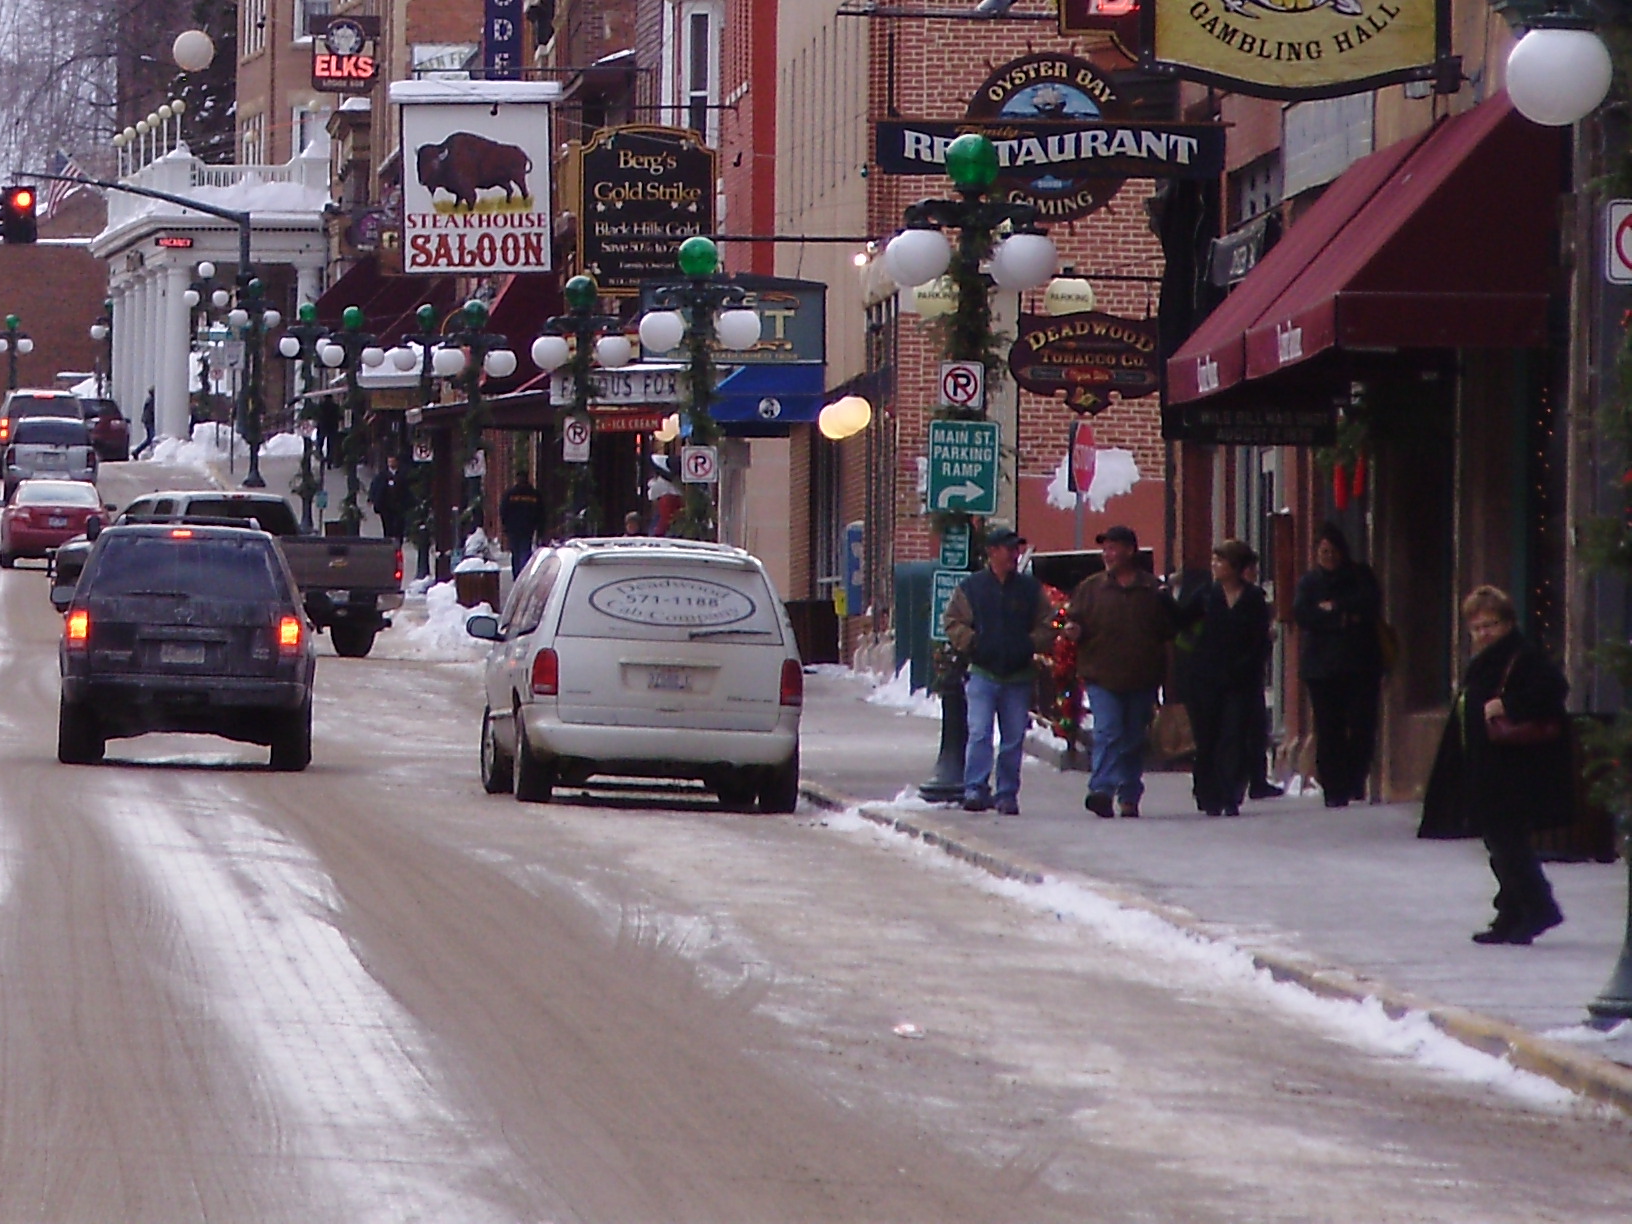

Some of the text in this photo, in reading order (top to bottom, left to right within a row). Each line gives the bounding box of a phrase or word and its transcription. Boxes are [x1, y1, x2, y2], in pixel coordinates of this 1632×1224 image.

[1188, 0, 1402, 62] GAMBLING HALL
[314, 54, 374, 78] ELKS
[988, 61, 1117, 104] OYSTER BAY
[902, 128, 1199, 168] RETAURANT
[619, 149, 678, 175] Berg's
[593, 181, 702, 201] Gold Strike
[406, 212, 547, 229] STEAKHOUSE
[594, 221, 701, 237] Black Hills Gold
[409, 232, 545, 269] SALOON
[1050, 293, 1090, 303] PARKING
[1027, 320, 1155, 353] DEADWOOD
[1041, 350, 1116, 366] TOBACCO
[560, 374, 633, 398] FOUS
[628, 417, 659, 430] CREAM
[933, 430, 994, 446] MAIN ST.
[933, 445, 992, 462] PARKING
[941, 461, 983, 477] RAMP
[616, 579, 732, 600] Deadwood
[625, 592, 720, 608] 571-1188
[606, 598, 741, 625] Cab Company
